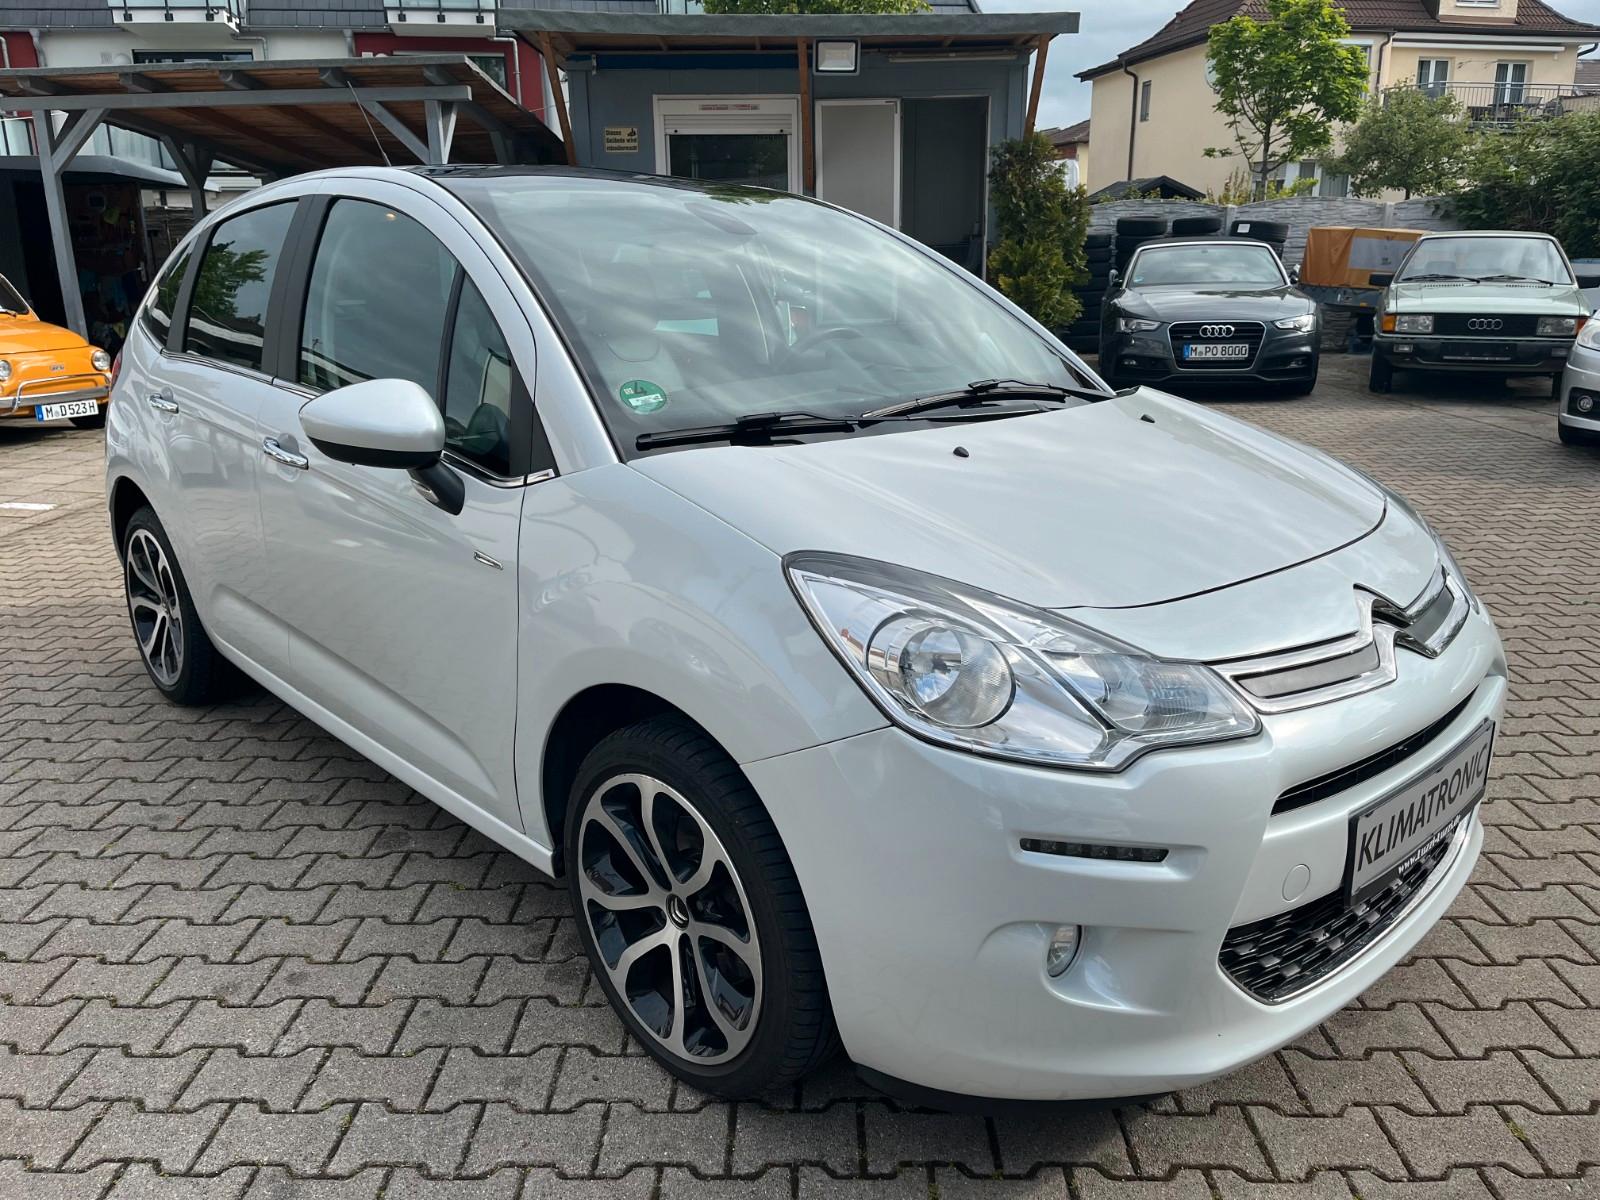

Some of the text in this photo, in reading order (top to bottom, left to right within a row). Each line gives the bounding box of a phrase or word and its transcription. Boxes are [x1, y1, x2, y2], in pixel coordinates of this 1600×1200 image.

[1190, 346, 1248, 356] M PO 8000
[45, 406, 54, 418] M
[1357, 743, 1488, 872] KLIMATRONIC
